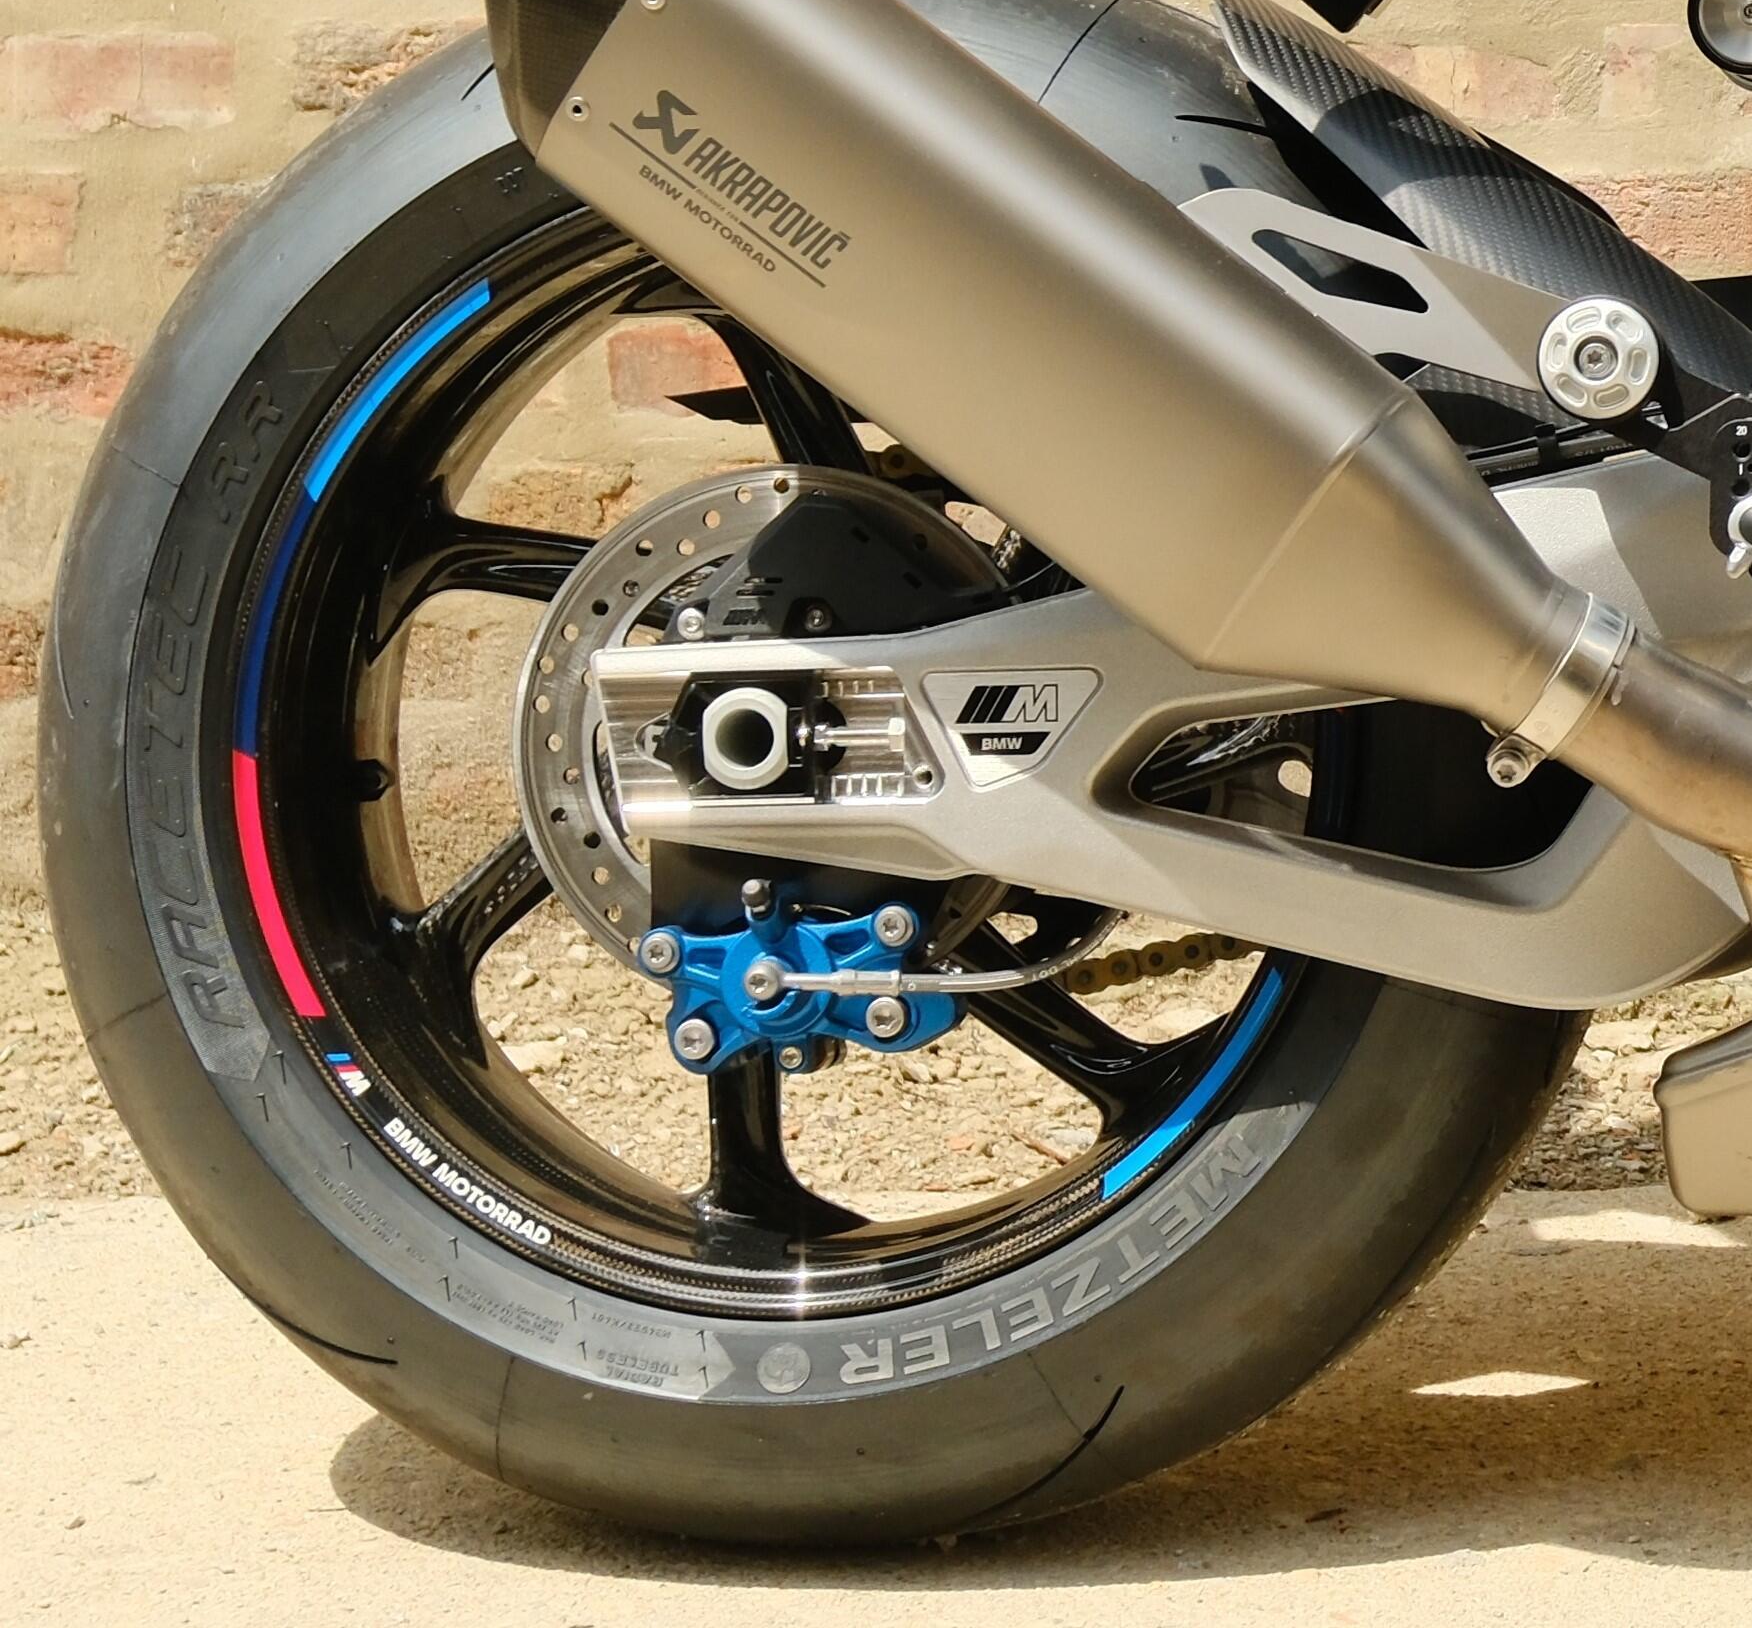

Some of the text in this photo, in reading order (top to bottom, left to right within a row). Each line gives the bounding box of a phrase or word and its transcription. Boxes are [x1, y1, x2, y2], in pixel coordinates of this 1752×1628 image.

[639, 164, 683, 201] BMW
[684, 199, 776, 273] MOTORRAD
[1735, 426, 1748, 436] 20
[143, 544, 245, 1028] RACETEC
[981, 737, 1023, 751] BMW
[384, 1117, 437, 1168] BMW
[432, 1162, 551, 1246] MOTORRAD
[840, 1135, 1262, 1385] METZELER
